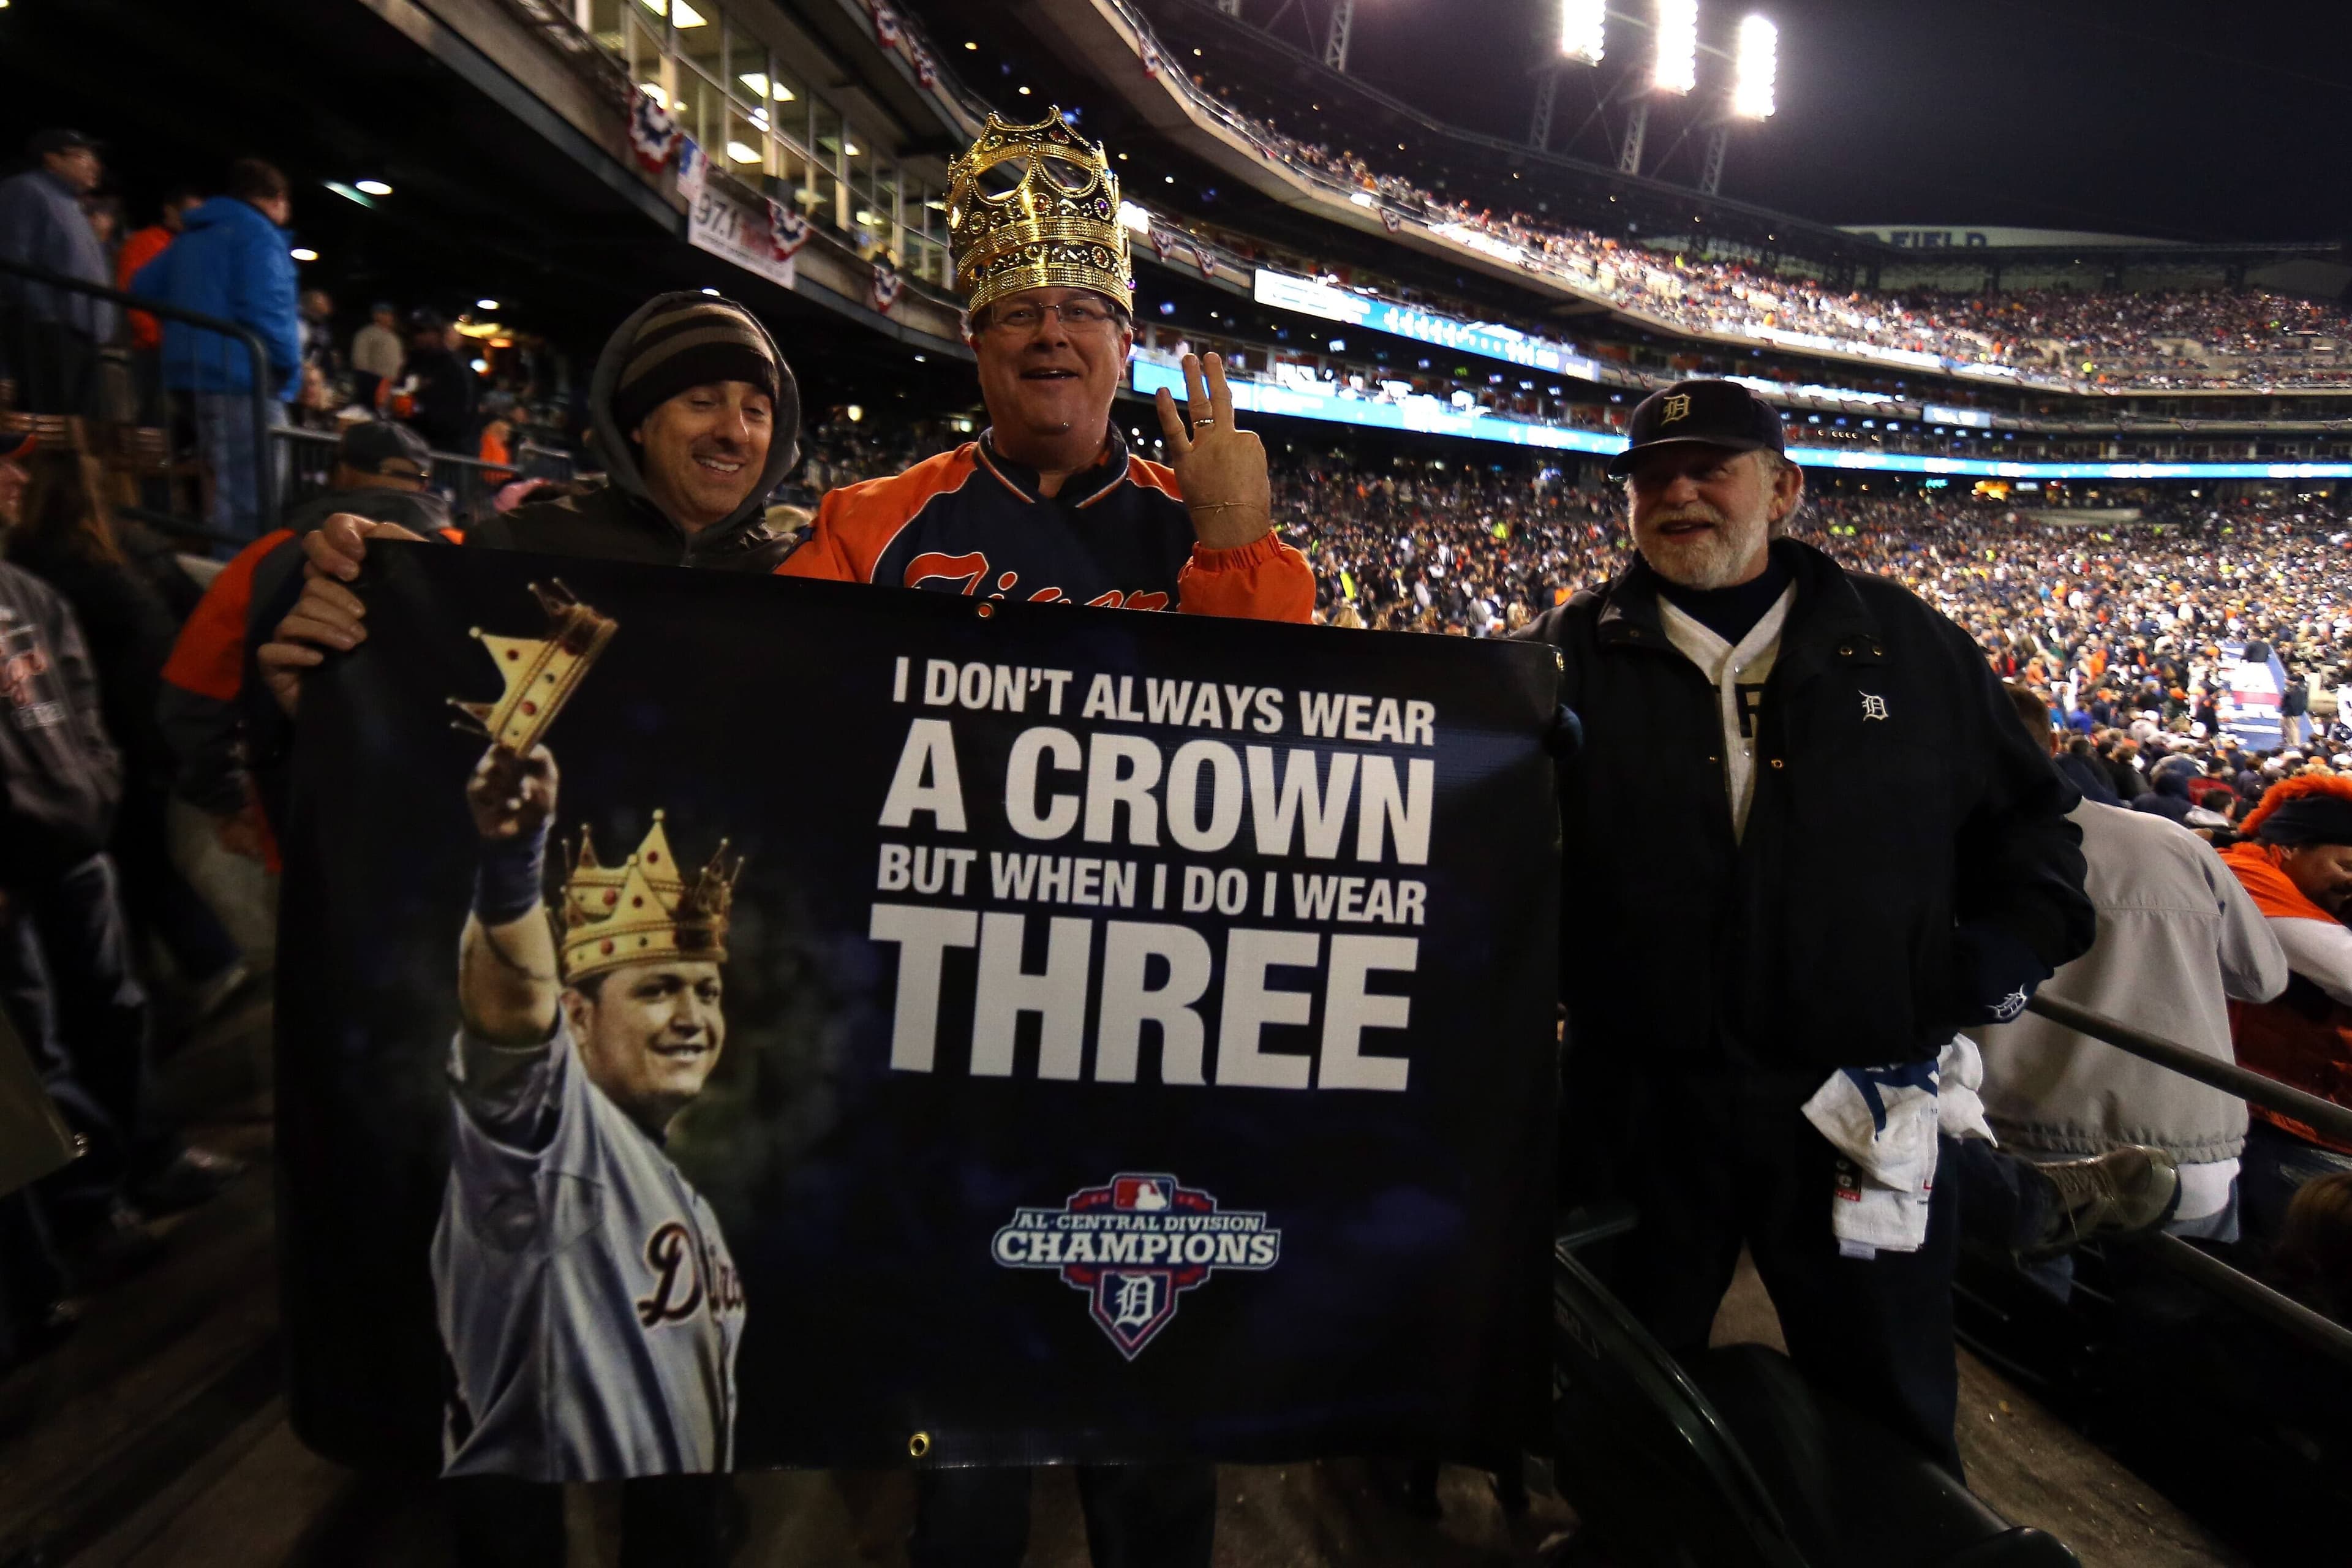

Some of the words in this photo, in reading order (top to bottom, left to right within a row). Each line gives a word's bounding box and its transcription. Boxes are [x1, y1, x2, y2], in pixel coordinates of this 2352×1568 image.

[893, 656, 910, 703] I
[924, 659, 1072, 715] DON'T
[1081, 673, 1284, 733] ALWAYS
[1299, 690, 1436, 746] WEAR
[878, 718, 967, 832] A
[1005, 726, 1435, 865] CROWN
[877, 843, 977, 895] BUT
[990, 852, 1137, 907] WHEN
[1152, 863, 1167, 910] I
[1182, 866, 1248, 916] DO
[1262, 871, 1278, 917] I
[1292, 873, 1427, 925] WEAR
[869, 903, 1419, 1091] THREE
[996, 1231, 1276, 1265] CHAMPIONS
[1163, 1215, 1260, 1232] DIVISION
